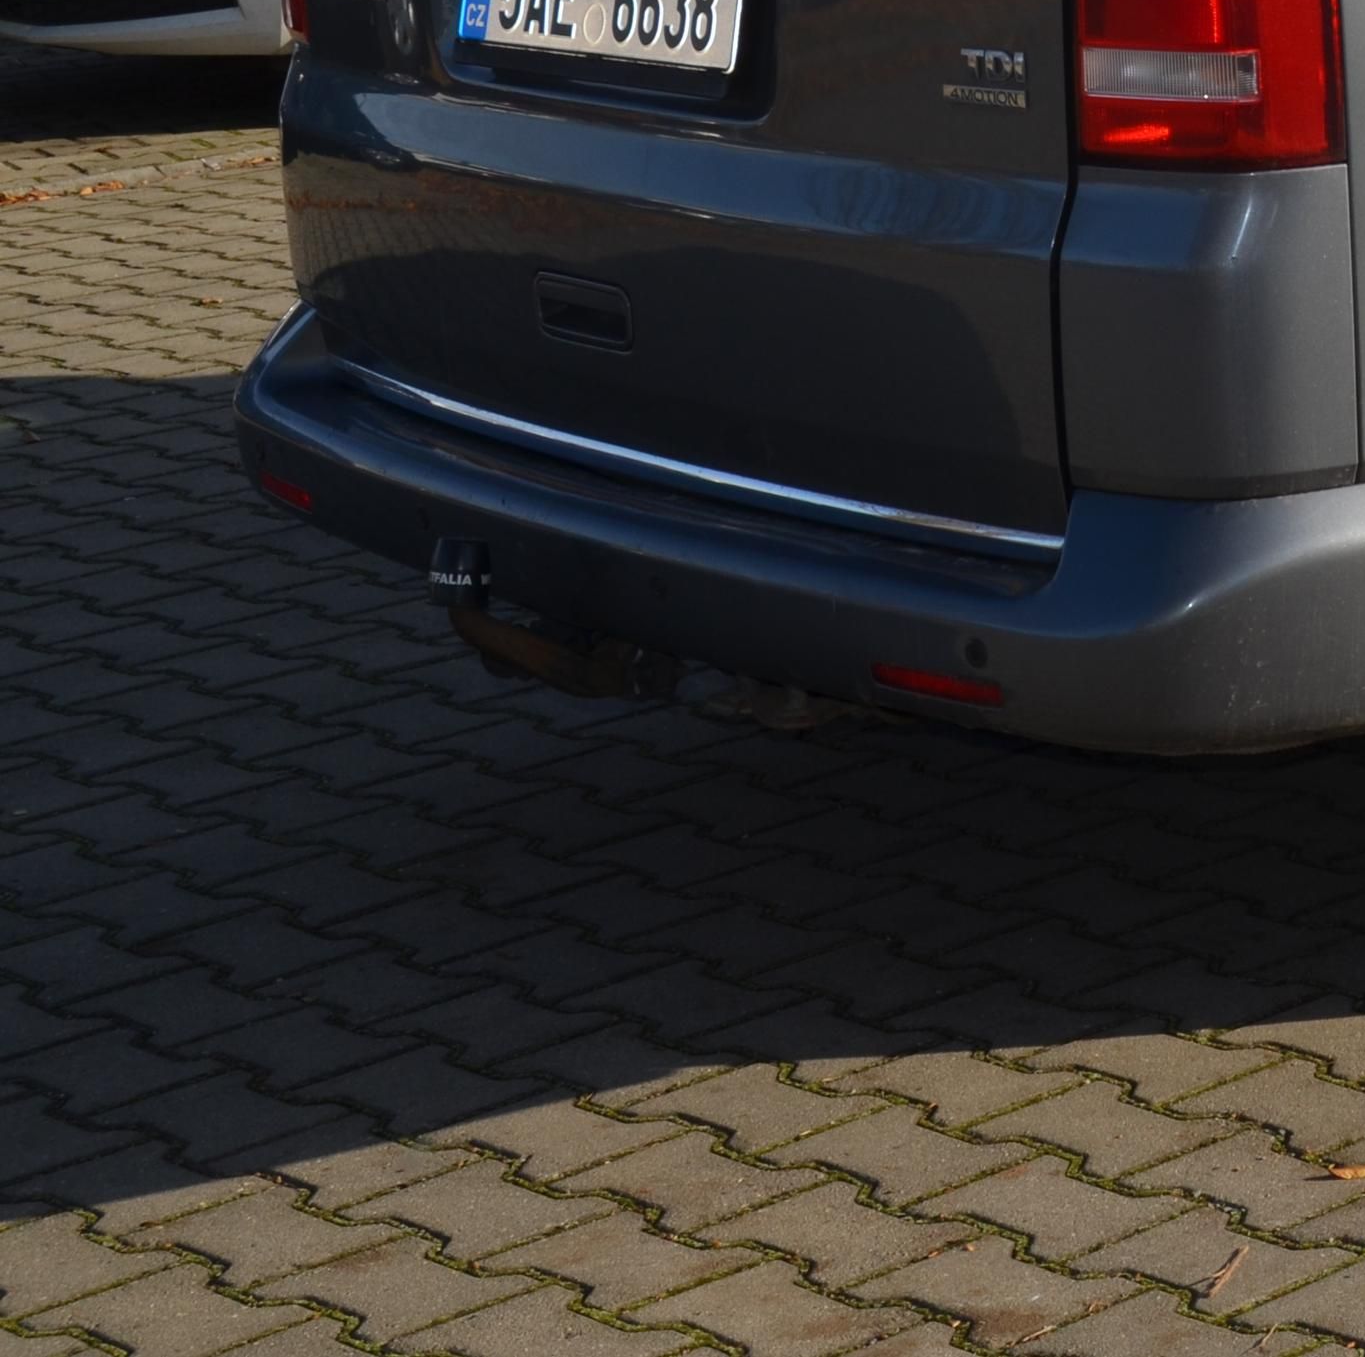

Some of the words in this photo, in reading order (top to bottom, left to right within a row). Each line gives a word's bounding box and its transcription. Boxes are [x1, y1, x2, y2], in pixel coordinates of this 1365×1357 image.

[465, 3, 488, 28] CZ
[960, 47, 1026, 84] TDI
[950, 88, 1020, 107] 4MOTION
[429, 571, 473, 586] TFALIA
